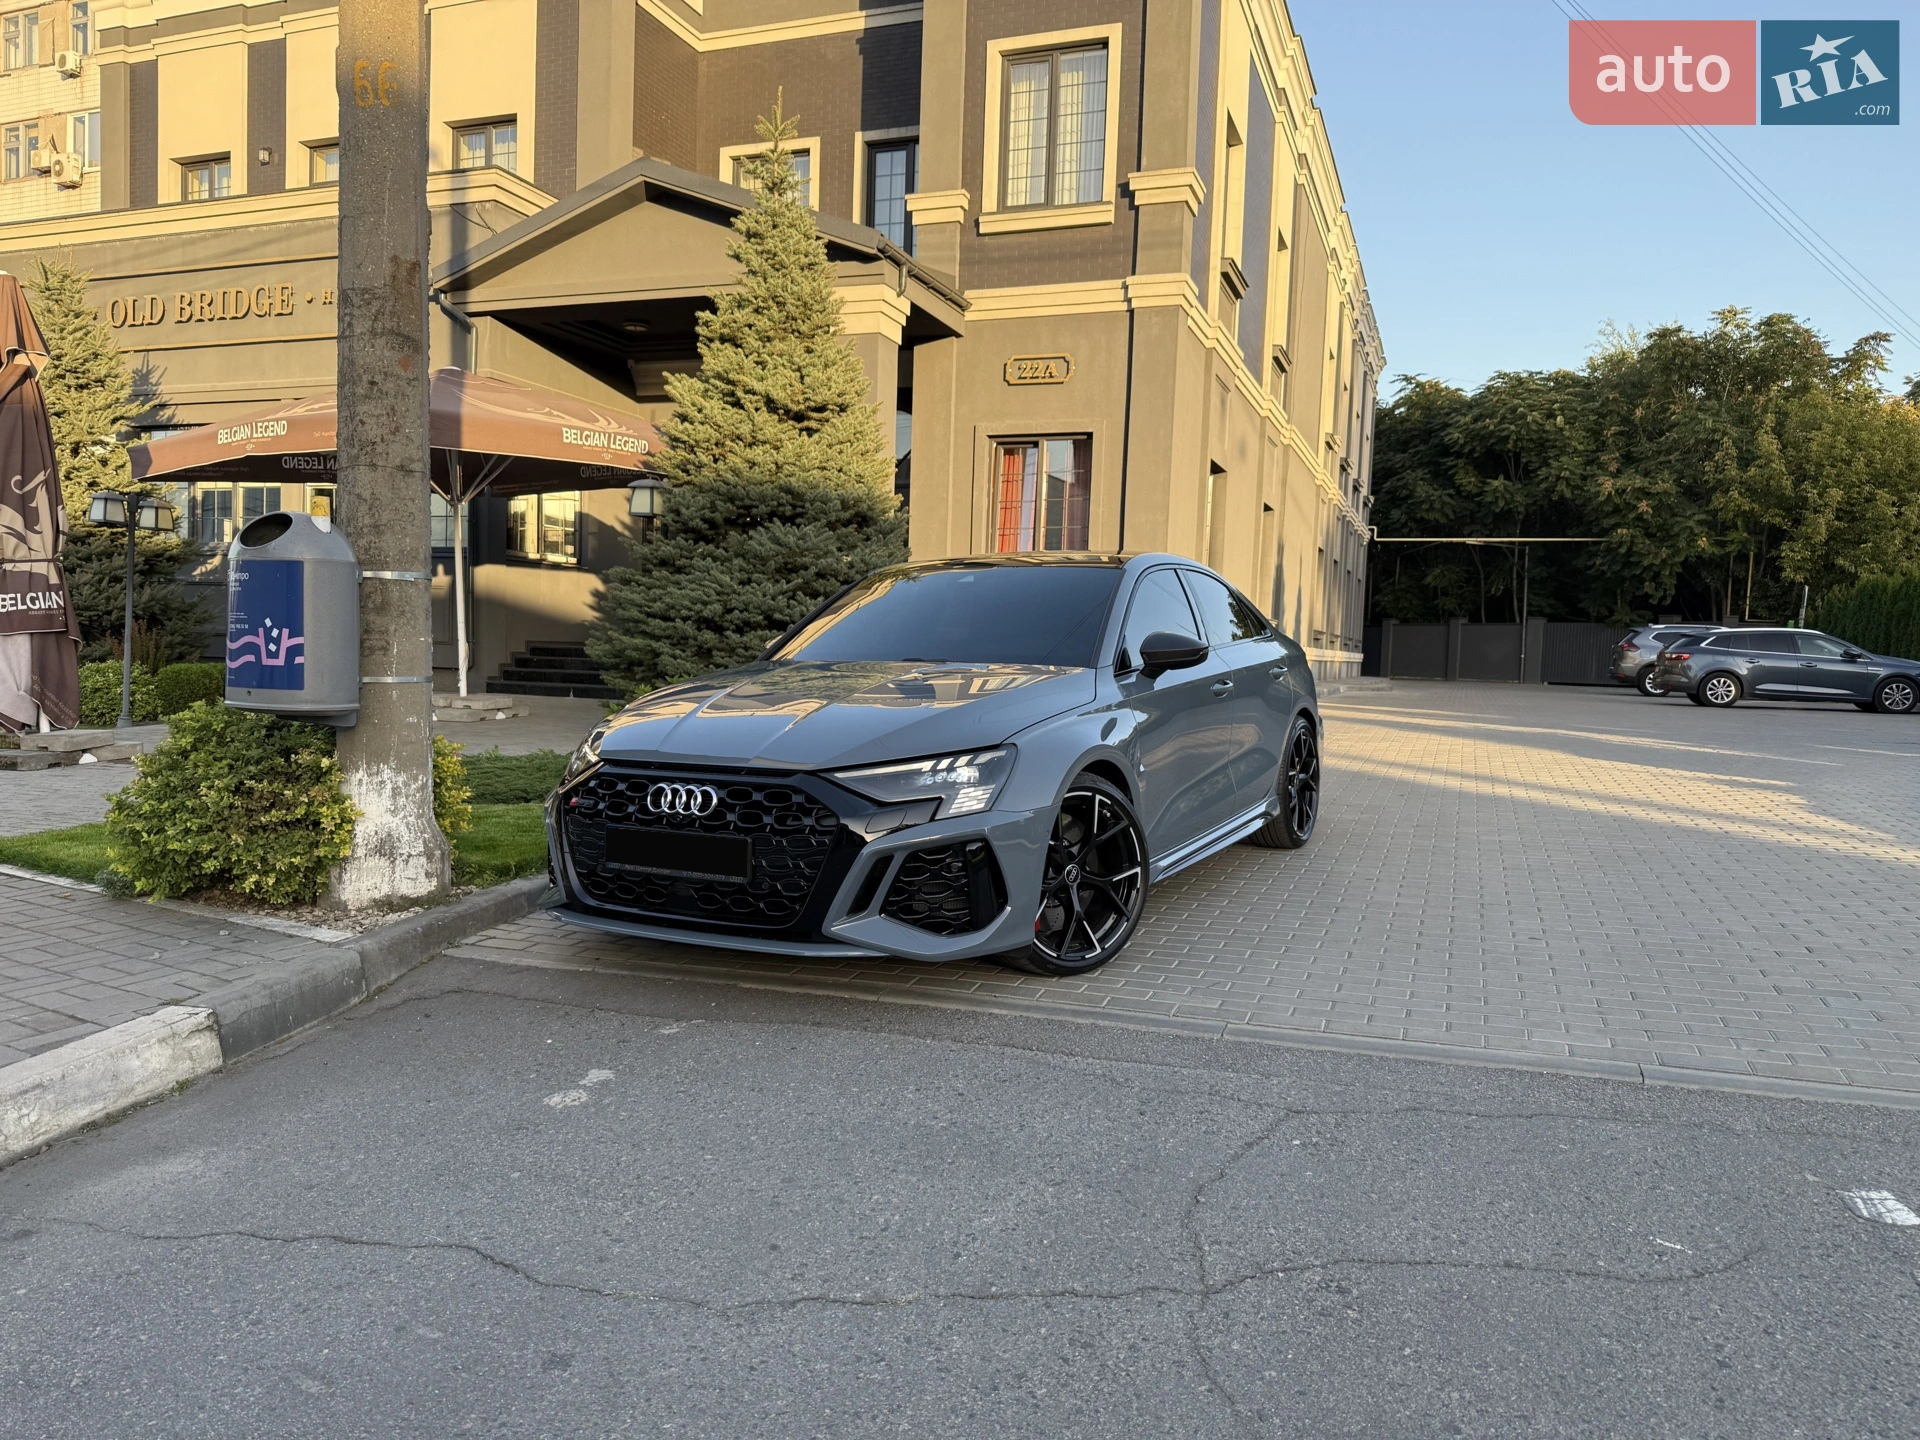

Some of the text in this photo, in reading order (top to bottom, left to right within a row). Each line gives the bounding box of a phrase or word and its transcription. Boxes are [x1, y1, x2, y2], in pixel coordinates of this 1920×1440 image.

[106, 294, 165, 328] OLD
[173, 282, 294, 324] BRIDGE
[1018, 361, 1059, 379] 22A
[218, 423, 250, 444] BELGIAN
[253, 420, 287, 437] LEGEND
[562, 427, 608, 447] BELGIAN
[610, 433, 649, 454] LEGEND
[0, 591, 65, 612] BELGIAN
